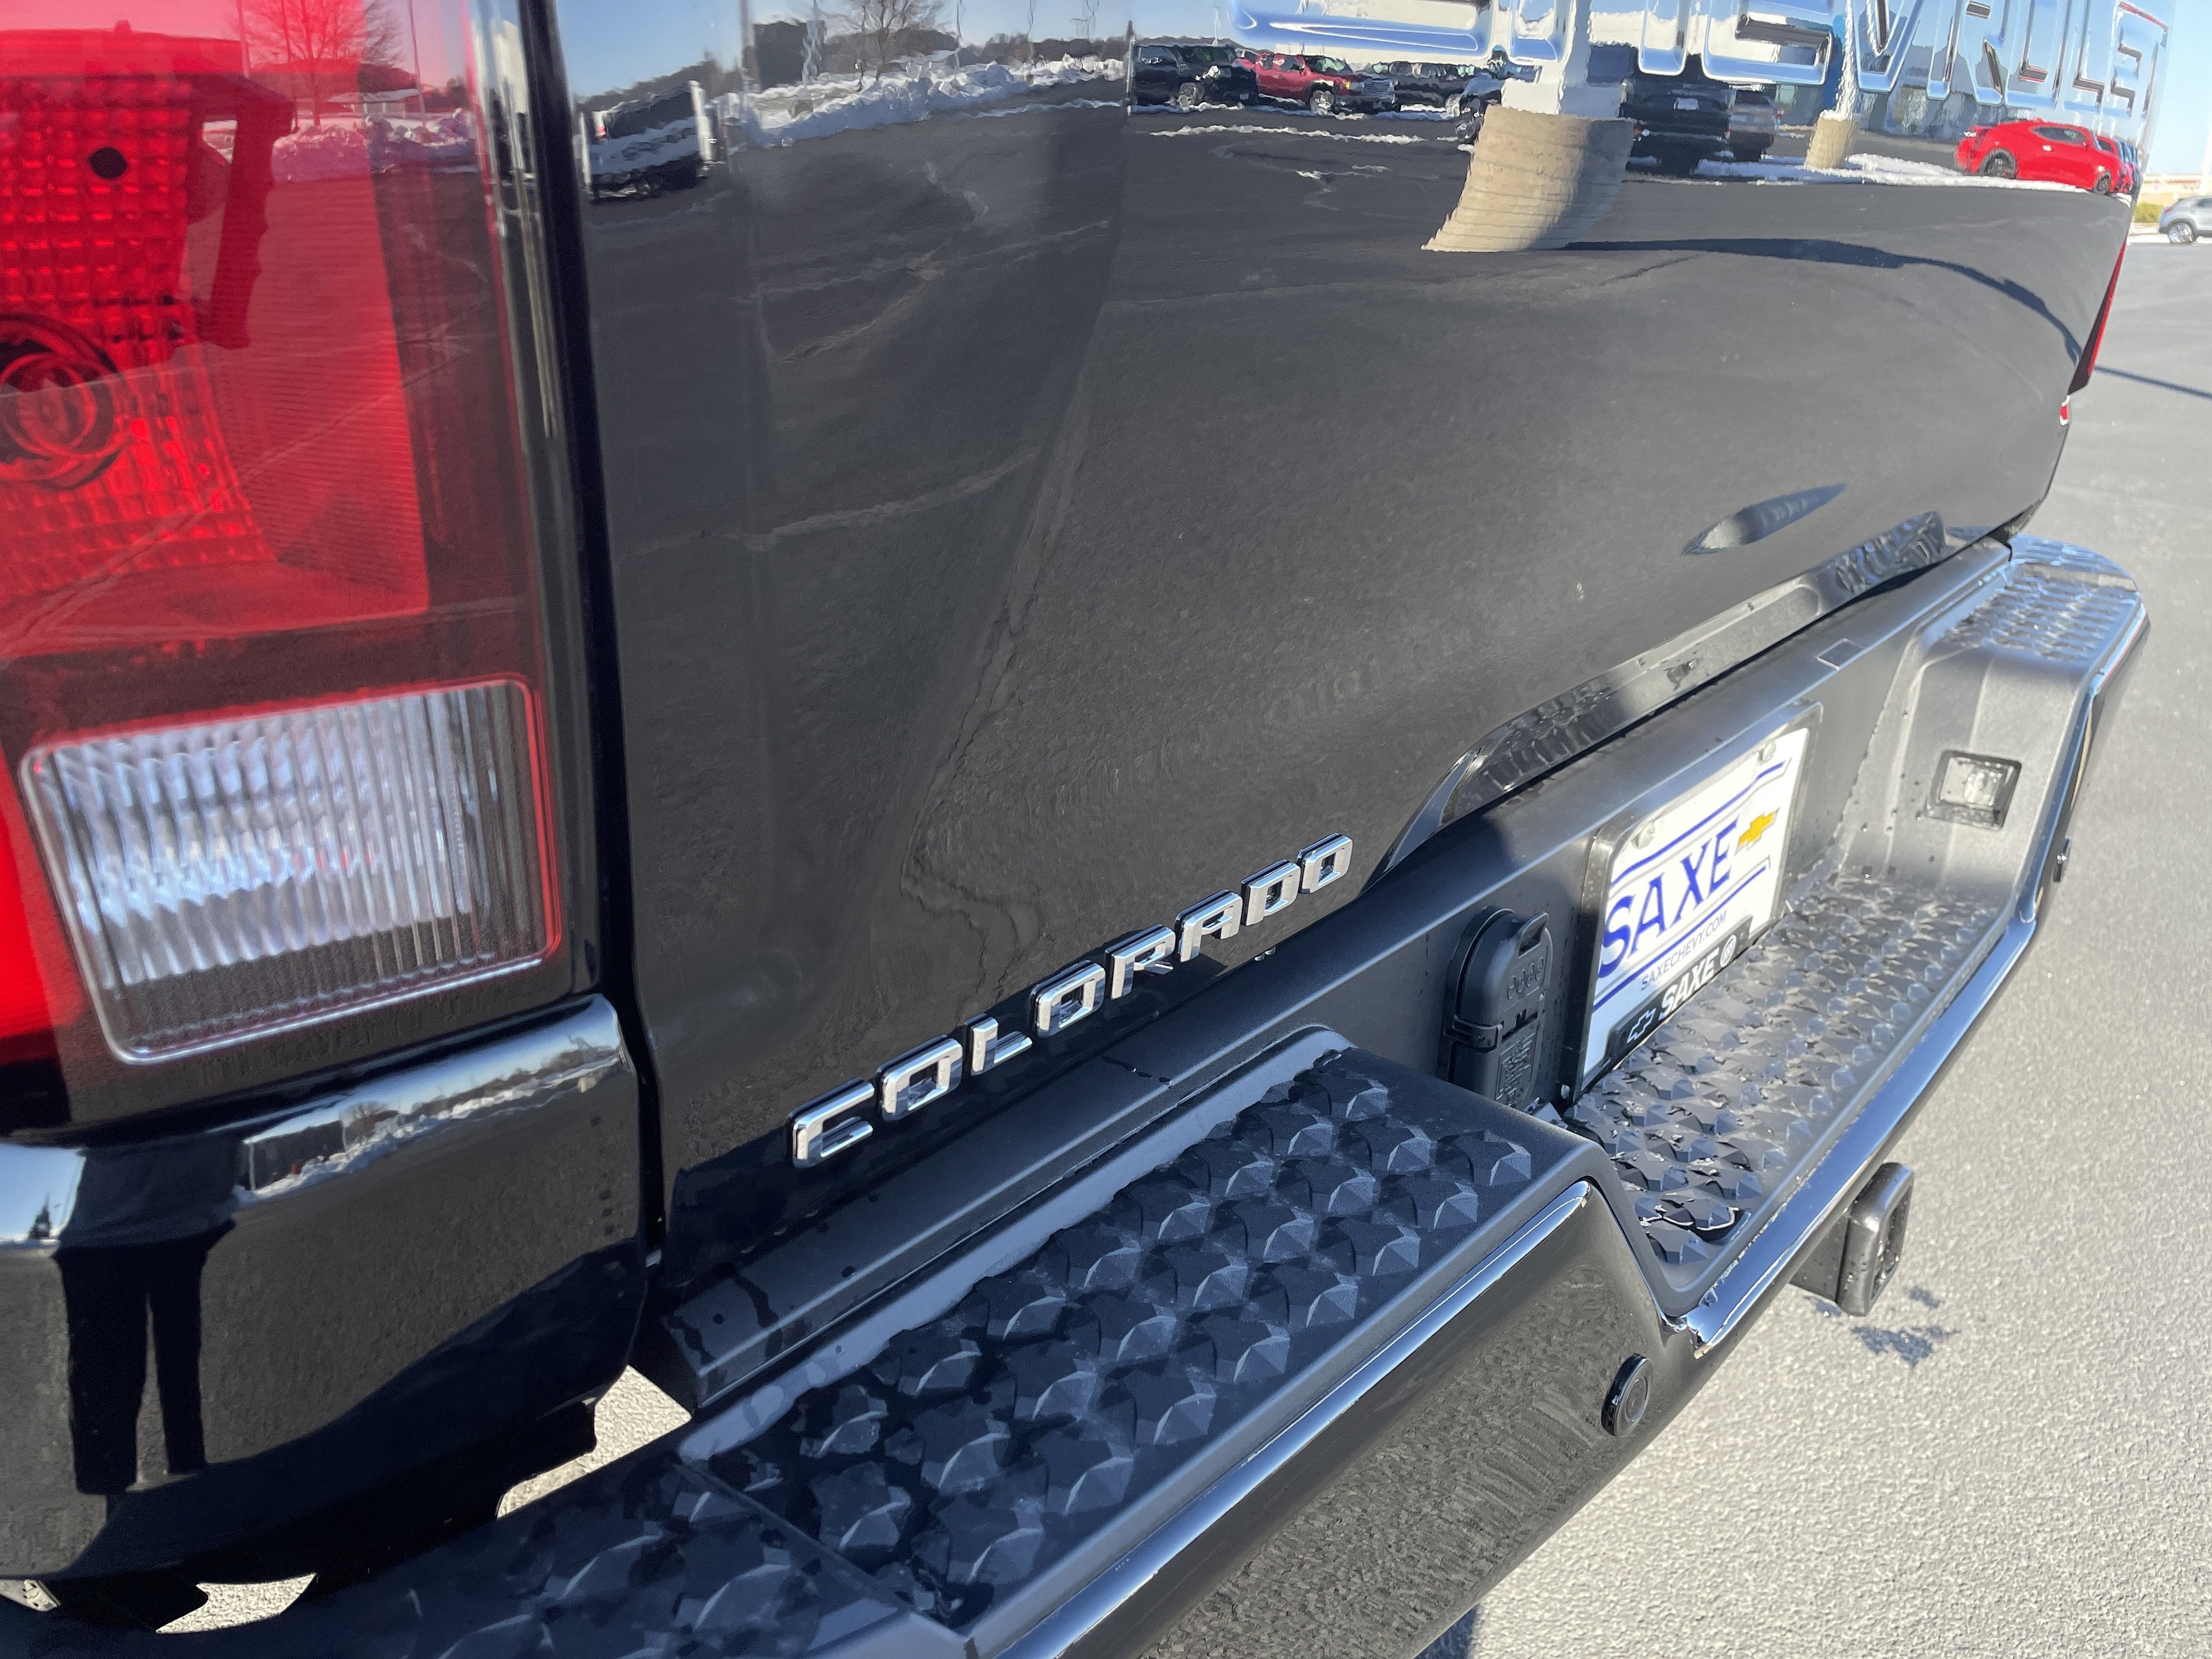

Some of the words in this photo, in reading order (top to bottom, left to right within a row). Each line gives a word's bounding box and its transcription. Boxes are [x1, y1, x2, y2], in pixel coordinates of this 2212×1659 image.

[1227, 0, 2168, 119] EVROLET
[1598, 814, 1740, 978] SAXE
[1640, 910, 1727, 991] SAXECHEVY.COM
[788, 832, 1353, 1169] COLORADO
[1658, 947, 1720, 1021] SAXE
